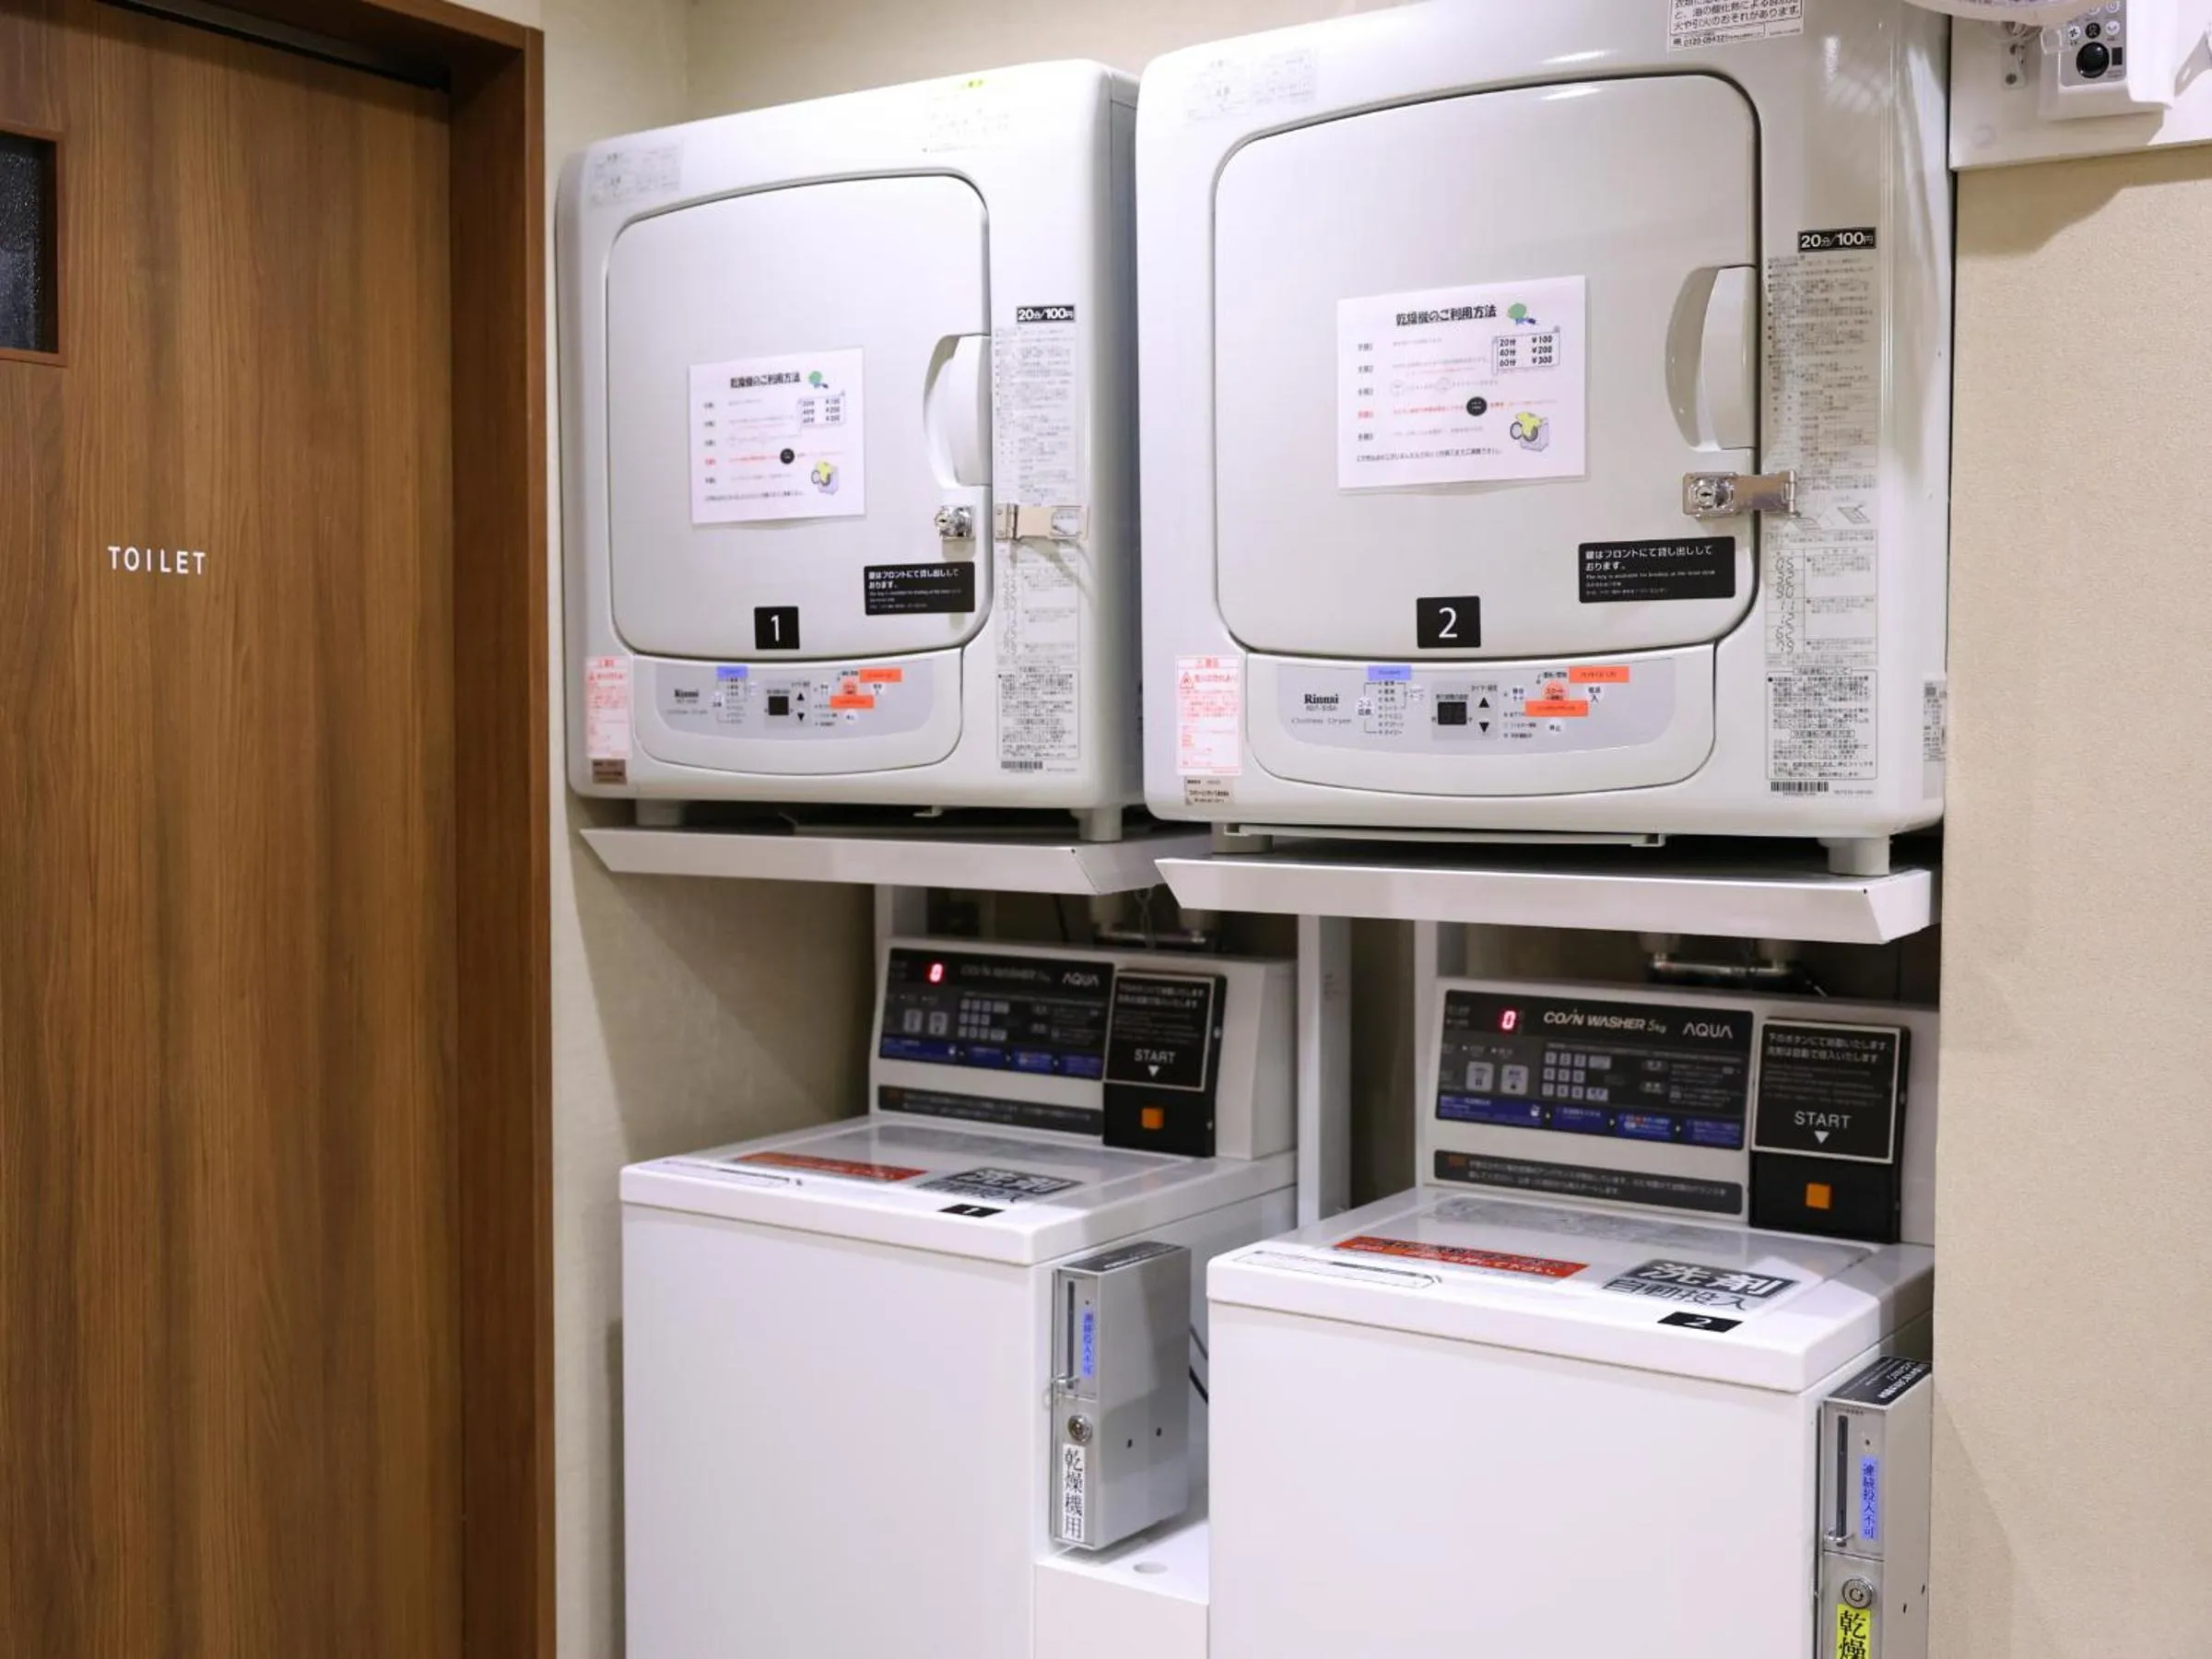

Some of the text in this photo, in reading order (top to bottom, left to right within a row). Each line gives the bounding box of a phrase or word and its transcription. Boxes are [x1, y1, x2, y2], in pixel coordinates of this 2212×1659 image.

[1395, 304, 1498, 326] 乾燥機のご利用方法
[108, 546, 207, 575] TOILET
[770, 615, 780, 642] 1
[1438, 607, 1458, 639] 2
[1304, 693, 1339, 705] Rinnai
[929, 962, 944, 983] 0
[1062, 972, 1100, 988] AQUA
[1500, 1010, 1517, 1030] 0
[1586, 1016, 1646, 1030] WASHER
[1682, 1021, 1734, 1040] AQUA
[1135, 1048, 1176, 1064] START
[1794, 1111, 1852, 1130] START
[1640, 1259, 1781, 1295] 洗剤
[1602, 1277, 1747, 1312] 自動投入
[1688, 1315, 1712, 1329] 2
[1064, 1447, 1084, 1539] 乾燥機用
[1861, 1462, 1876, 1540] 連続投入不可
[1838, 1607, 1867, 1659] 乾燥
